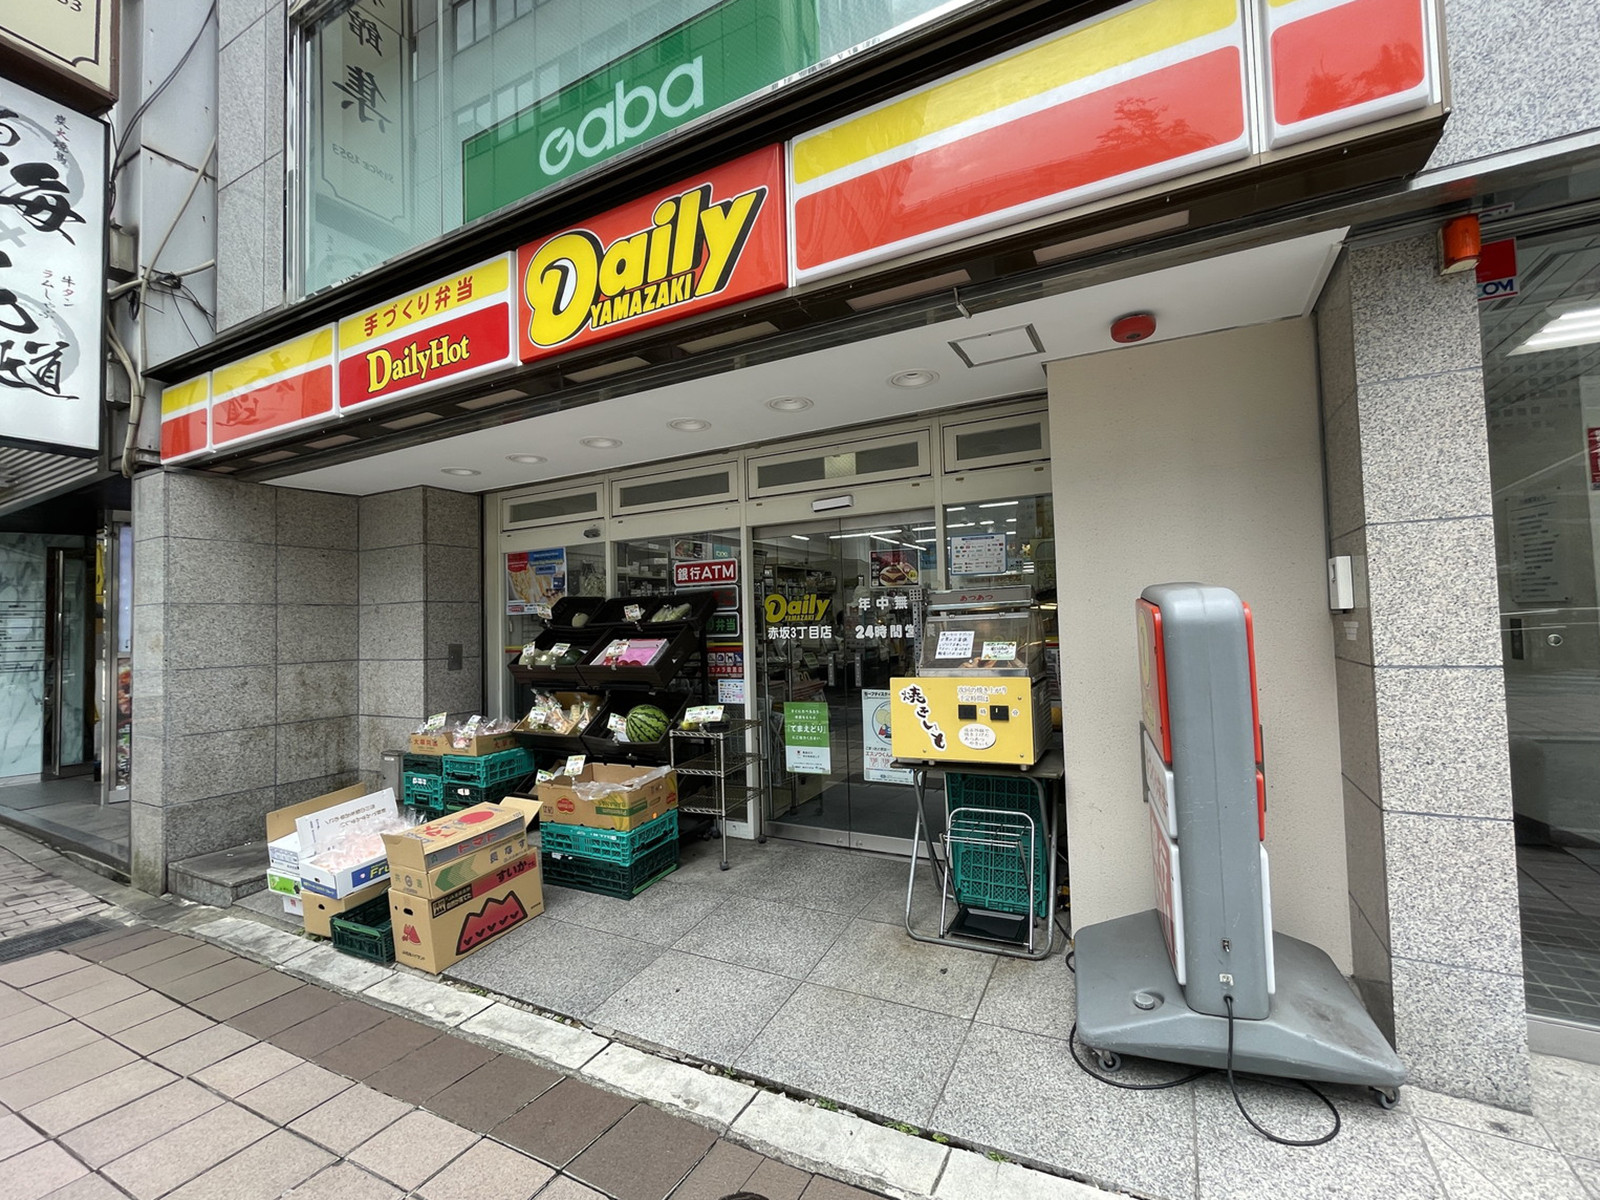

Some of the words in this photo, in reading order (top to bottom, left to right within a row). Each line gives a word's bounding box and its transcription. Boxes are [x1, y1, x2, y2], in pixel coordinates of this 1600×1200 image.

[539, 55, 704, 175] Gaba
[525, 184, 768, 347] Daily
[363, 275, 474, 338] 手づくり弁当
[591, 272, 695, 329] YAMAZAKI
[365, 334, 471, 394] DailyHot
[677, 563, 735, 581] 銀行ATM
[764, 593, 831, 623] Daily
[767, 625, 833, 640] 赤坂3丁目店
[901, 686, 946, 749] 焼きいも
[495, 860, 528, 883] すいか
